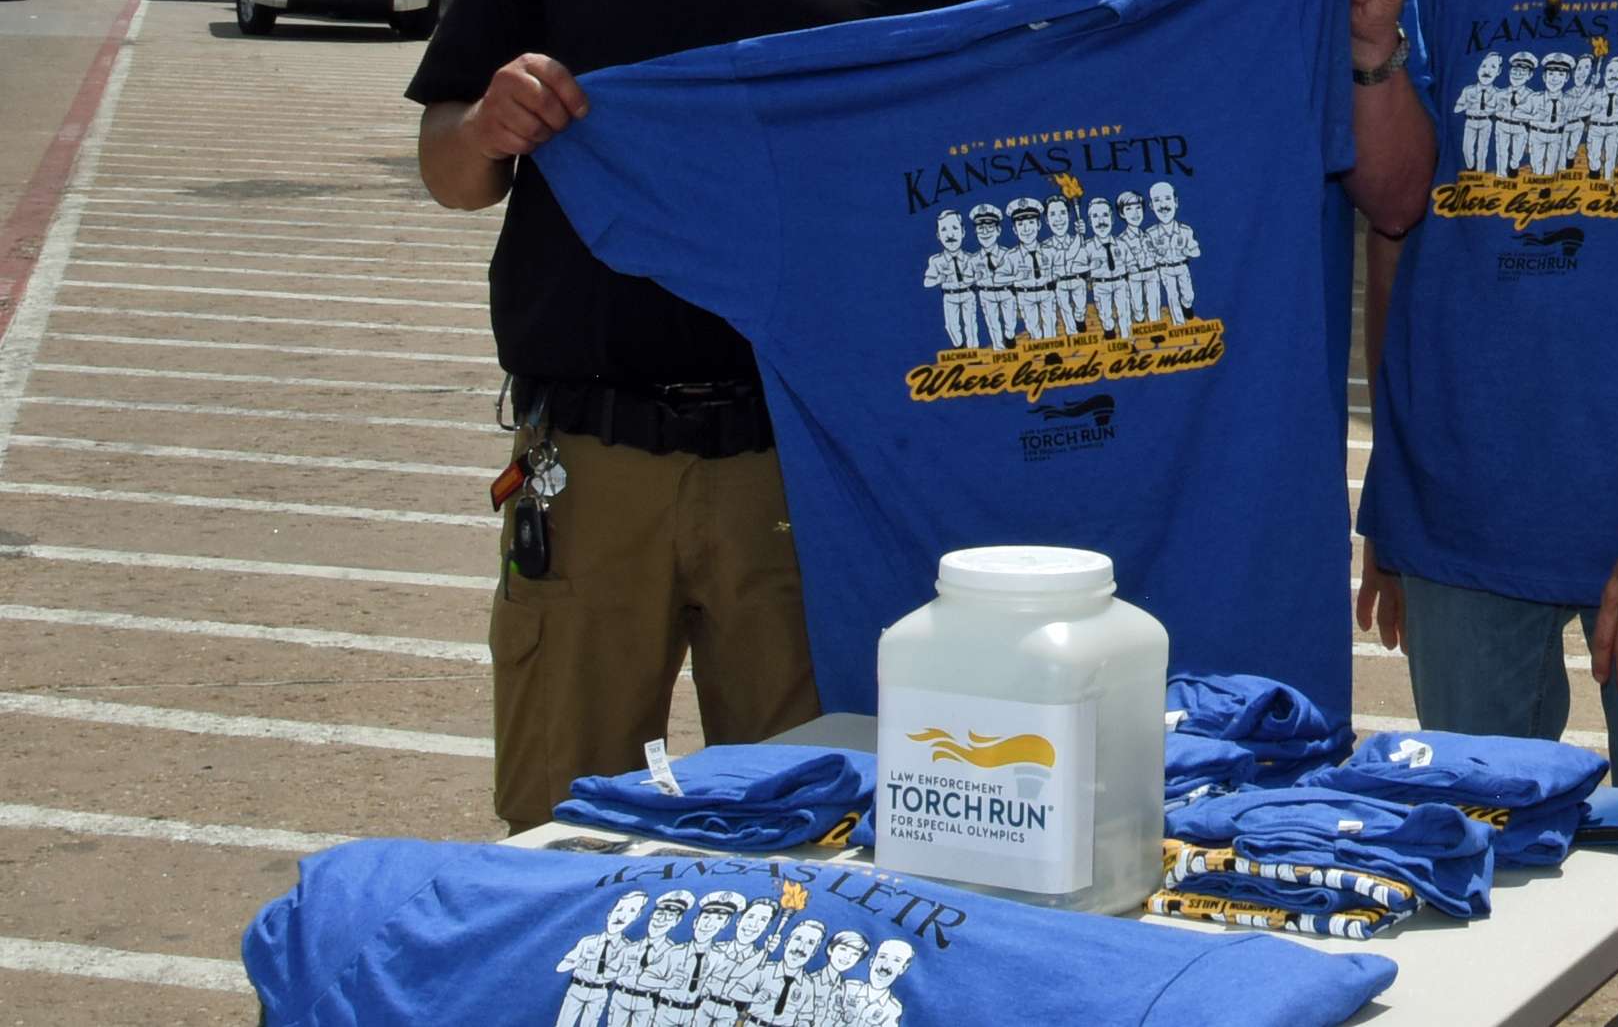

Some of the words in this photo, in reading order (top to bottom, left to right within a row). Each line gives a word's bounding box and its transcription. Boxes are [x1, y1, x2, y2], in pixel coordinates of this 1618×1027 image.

[1464, 14, 1609, 55] KANSAS
[995, 124, 1123, 149] ANNIVERSARY
[904, 145, 1072, 215] KANSAS
[1083, 135, 1194, 177] LETR
[1436, 185, 1501, 212] Where
[1504, 186, 1582, 225] legends
[1073, 335, 1099, 347] MILES
[911, 363, 1005, 396] Where
[1012, 349, 1104, 398] legends
[1109, 356, 1152, 374] are
[1156, 333, 1222, 367] made
[1019, 432, 1078, 450] TORCH
[1081, 426, 1115, 442] RUN
[890, 771, 914, 782] LAW
[918, 774, 1003, 795] ENFORCEMENT
[887, 783, 983, 822] TORCH
[890, 814, 914, 827] FOR
[916, 818, 963, 835] SPECIAL
[967, 826, 1025, 843] OLYMPICS
[890, 827, 934, 842] KANSAS
[826, 871, 967, 950] LETR
